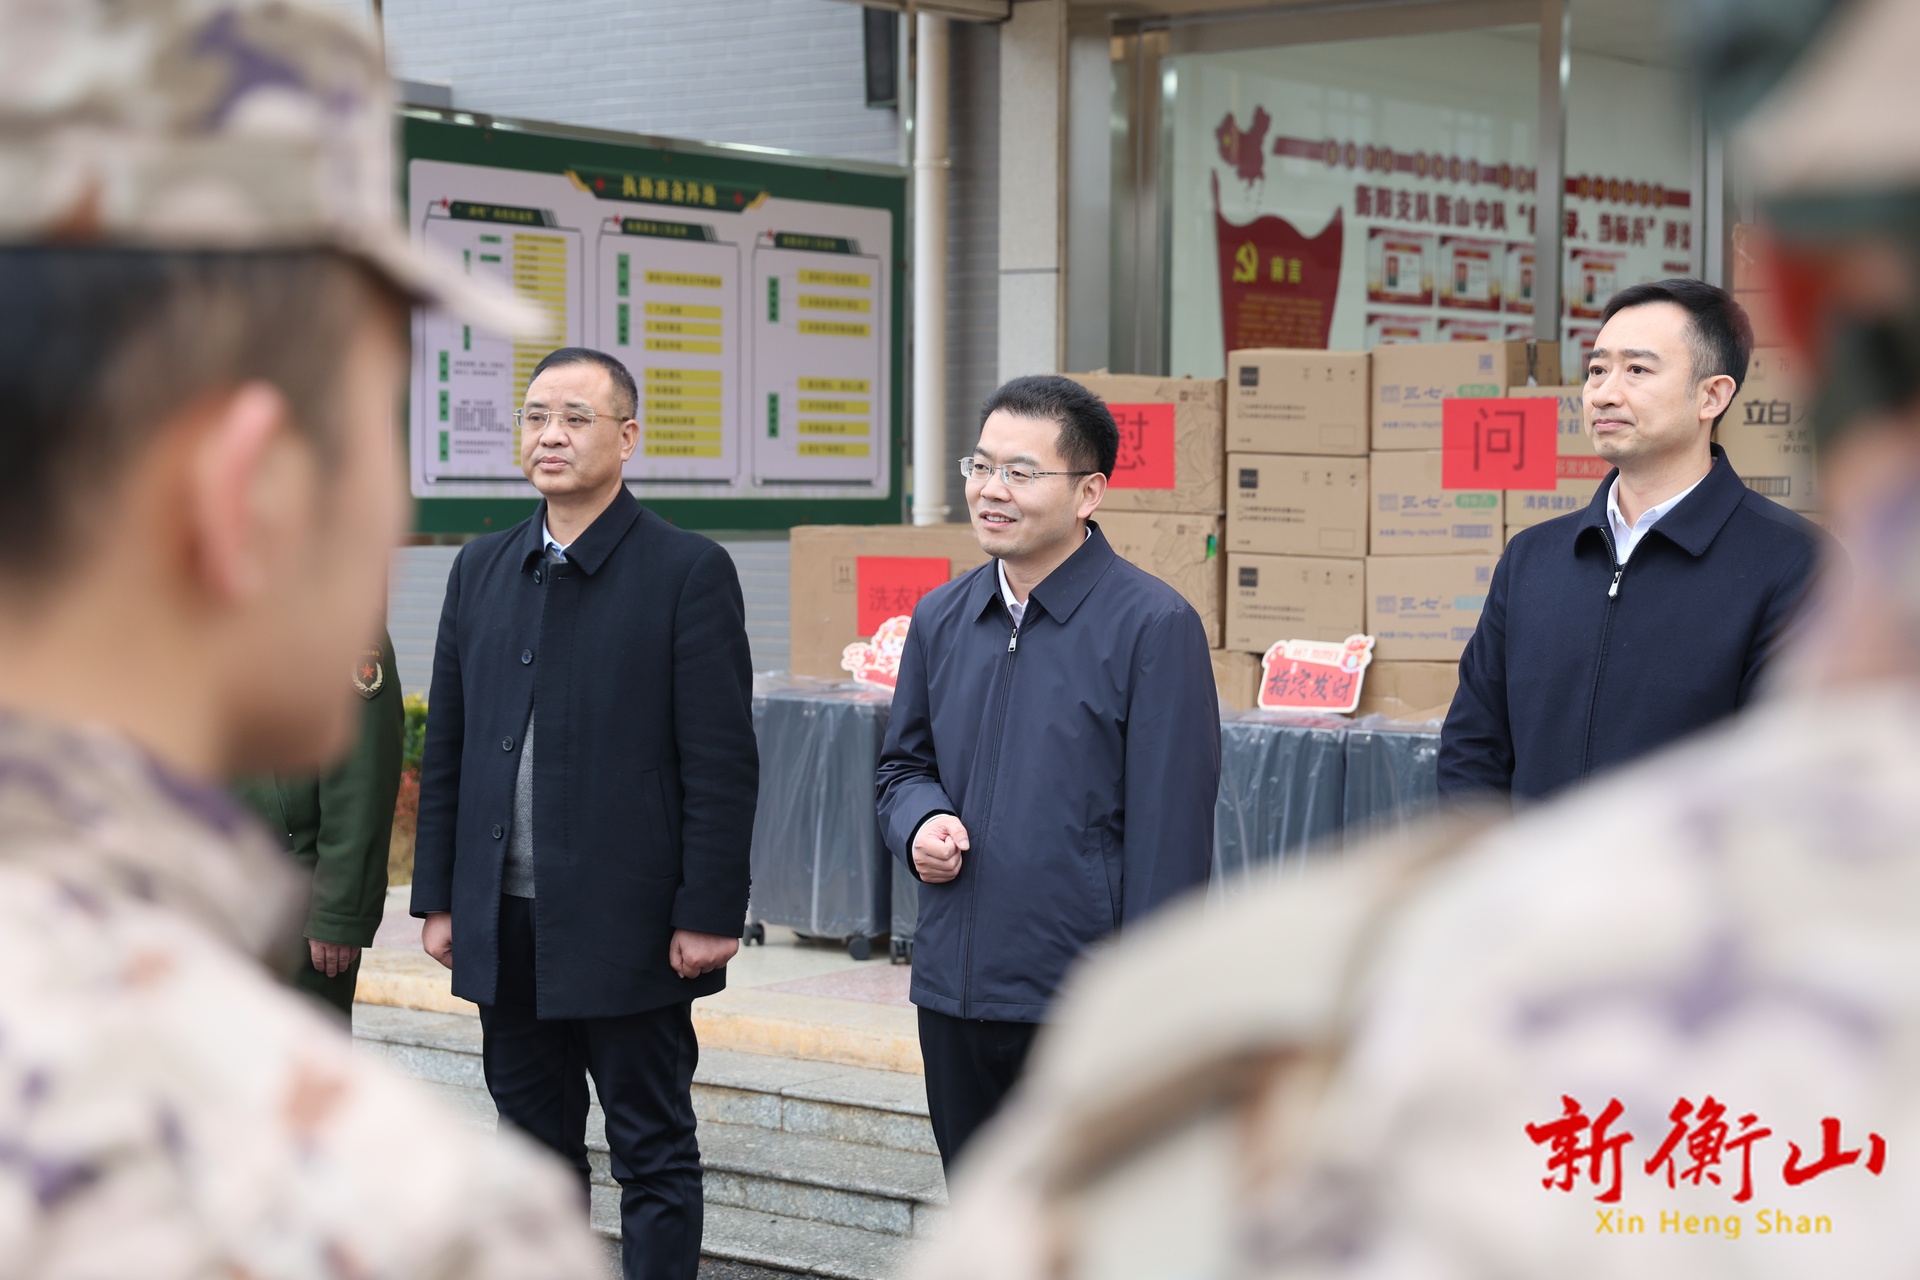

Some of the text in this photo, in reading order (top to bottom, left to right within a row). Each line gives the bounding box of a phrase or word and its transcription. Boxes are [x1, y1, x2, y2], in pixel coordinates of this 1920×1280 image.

[1473, 407, 1526, 472] 问
[1268, 668, 1353, 702] 指定发财
